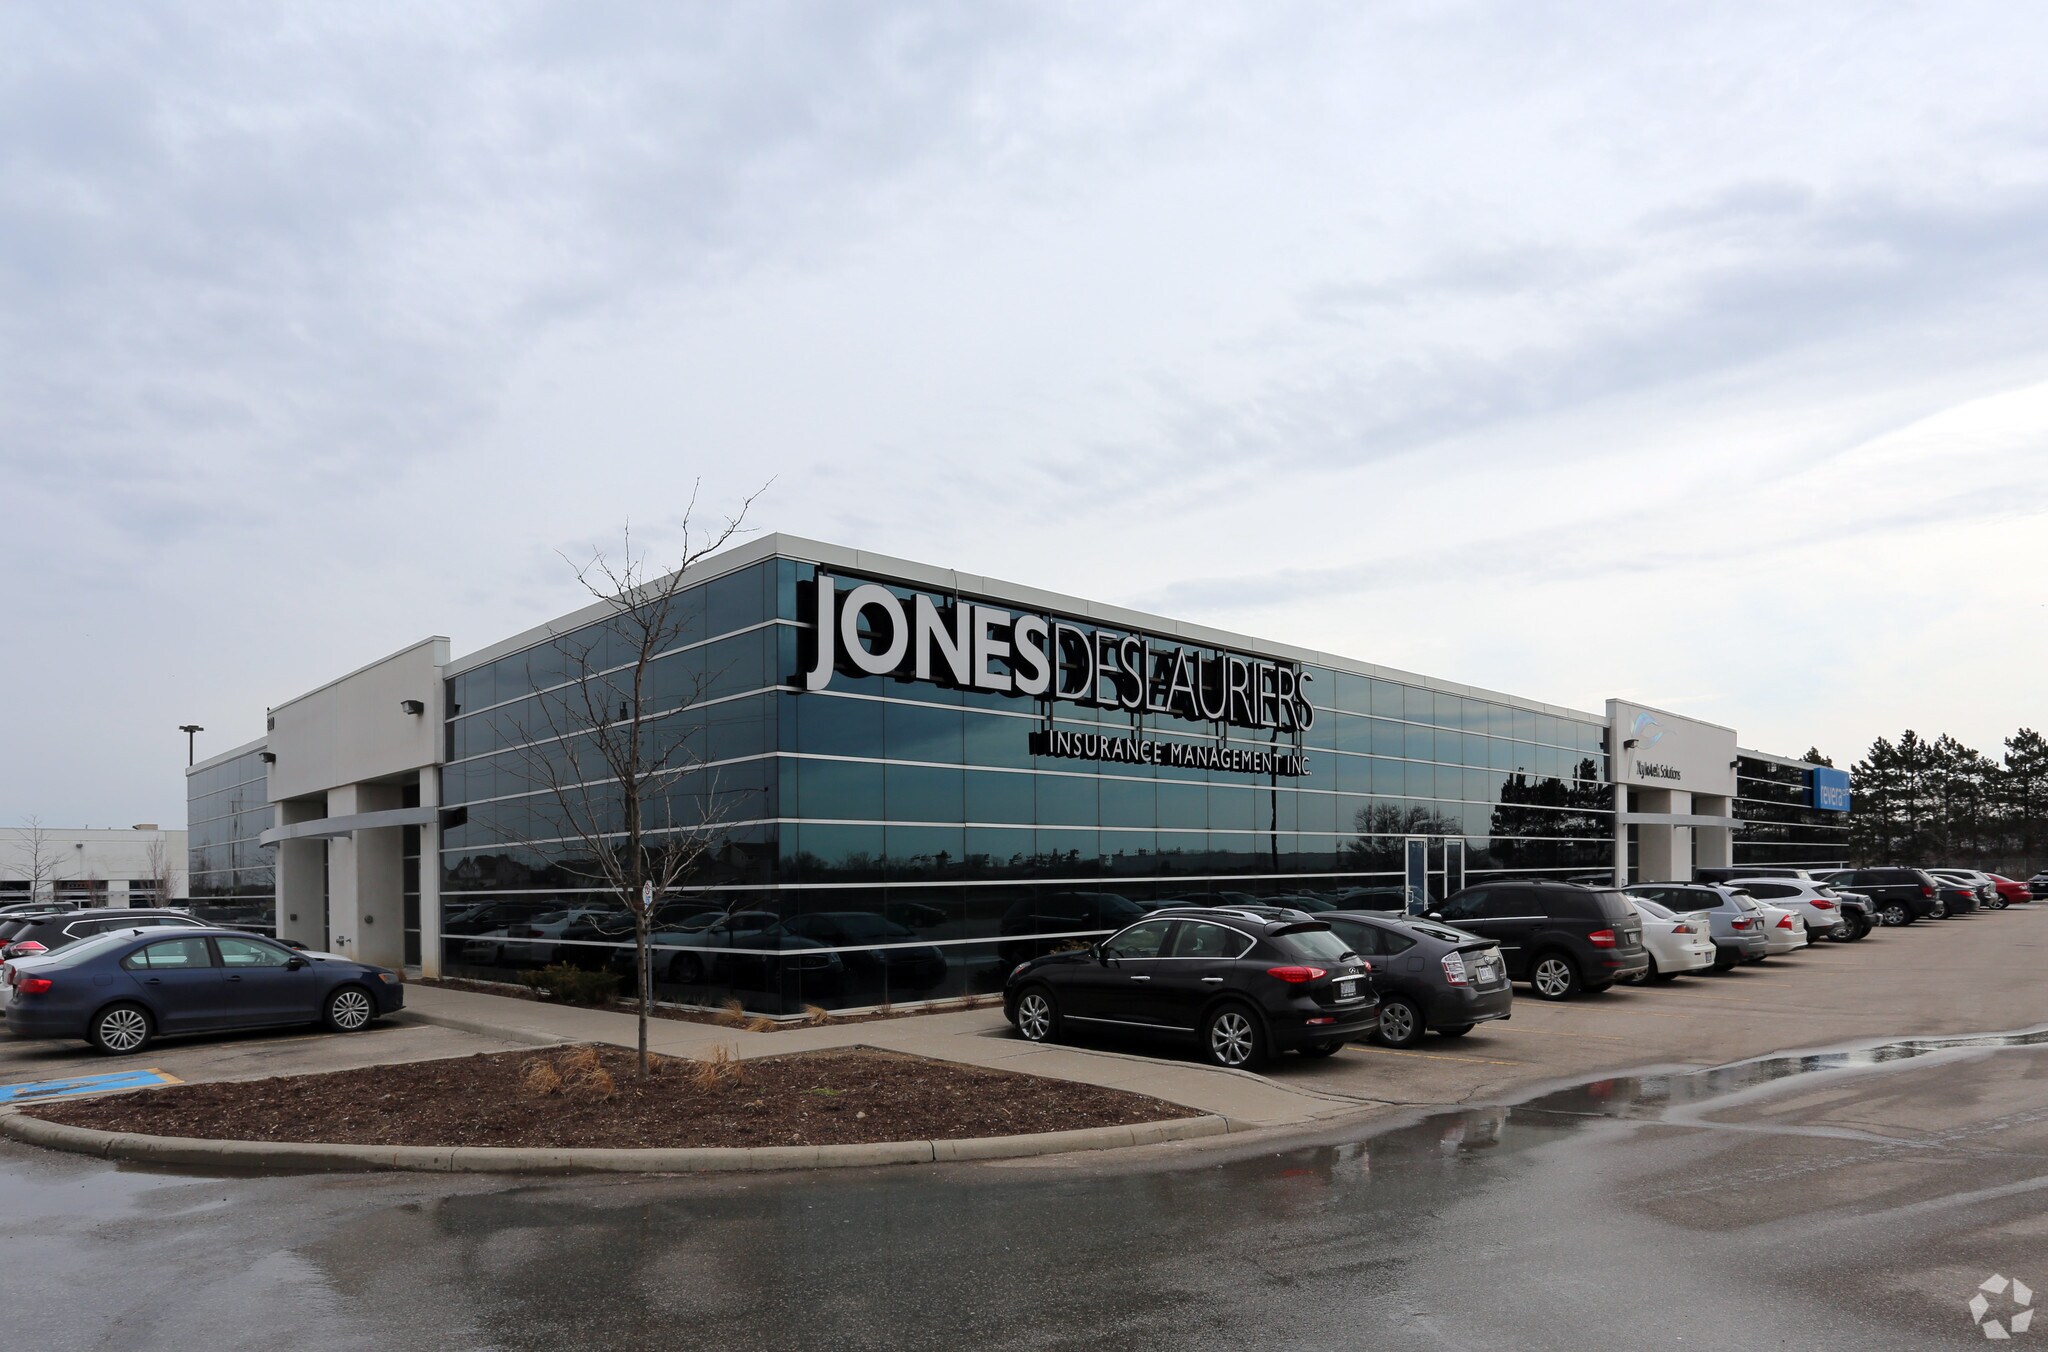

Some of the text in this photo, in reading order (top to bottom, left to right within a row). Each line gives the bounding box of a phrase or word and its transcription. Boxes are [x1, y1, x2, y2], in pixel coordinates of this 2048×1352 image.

[1049, 729, 1312, 775] INSURANCE MANAGEMENT INC.
[1660, 764, 1681, 780] Solutions
